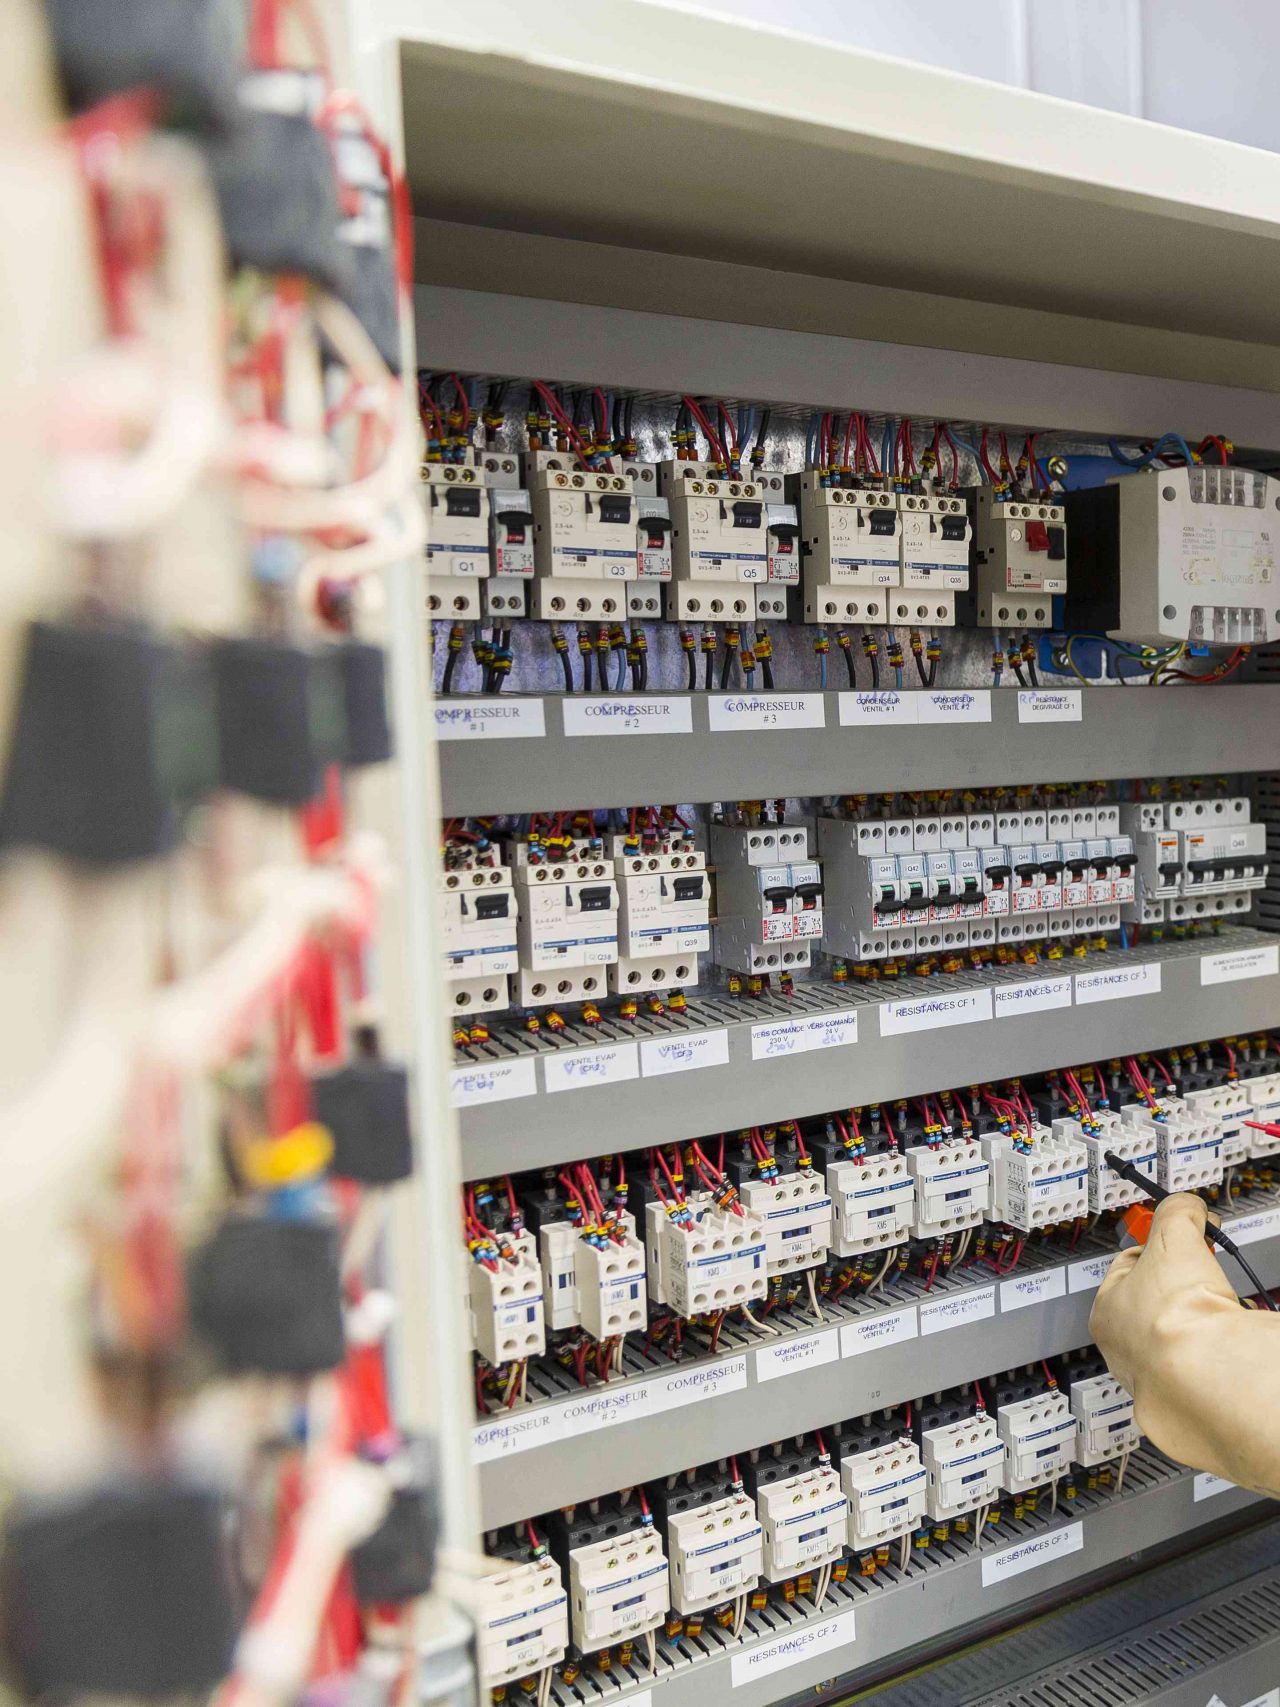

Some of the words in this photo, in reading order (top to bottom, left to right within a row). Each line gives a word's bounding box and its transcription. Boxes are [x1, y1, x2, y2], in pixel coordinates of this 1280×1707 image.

[459, 561, 474, 572] Q1
[610, 566, 626, 576] Q3
[743, 569, 757, 578] Q5
[878, 575, 891, 583] Q34
[950, 576, 962, 584] Q35
[728, 701, 805, 712] COMPRESSEUR
[856, 697, 900, 705] CONDENSEUR
[585, 705, 670, 717] COMPRESSEUR
[862, 705, 884, 713] VENTIL
[633, 718, 640, 728] 2
[771, 714, 777, 723] 3
[684, 939, 698, 947] Q39
[1077, 973, 1129, 989] RESISTANCES
[996, 985, 1051, 1001] RESISTANCES
[1053, 983, 1063, 993] CF
[1065, 982, 1071, 991] 2
[896, 1001, 955, 1017] RESISTANCES
[957, 999, 969, 1008] CF
[971, 998, 975, 1006] 1
[807, 1022, 824, 1030] VERS
[825, 1017, 856, 1028] COMANDE
[752, 1031, 770, 1039] VERS
[771, 1025, 804, 1037] COMANDE
[662, 1042, 686, 1052] VENTIL
[688, 1039, 708, 1048] EVAP
[567, 1057, 591, 1066] VENTIL
[595, 1053, 616, 1062] EVAP
[953, 1205, 963, 1215] KM6
[876, 1219, 888, 1231] KM5
[791, 1243, 803, 1253] KM4
[1082, 1263, 1100, 1272] VENTIL
[1015, 1282, 1034, 1291] VENTIL
[1035, 1276, 1050, 1285] EVAP
[920, 1302, 957, 1317] RESISTANCE
[960, 1292, 994, 1306] DEGIVRAGE
[857, 1317, 901, 1334] CONDENSEUR
[863, 1329, 884, 1340] VENTIL
[774, 1340, 820, 1357] CONDENSEUR
[781, 1353, 803, 1363] VENTIL
[667, 1363, 745, 1392] COMPRESSEUR
[710, 1382, 717, 1391] 3
[563, 1389, 648, 1419] COMPRESSEUR
[610, 1409, 617, 1419] 2
[996, 1540, 1049, 1567] RESISTANCES
[1051, 1534, 1062, 1545] CF
[1064, 1532, 1069, 1540] 3
[749, 1633, 814, 1664] RESISTANCES
[817, 1625, 830, 1638] CF
[832, 1623, 838, 1633] 2
